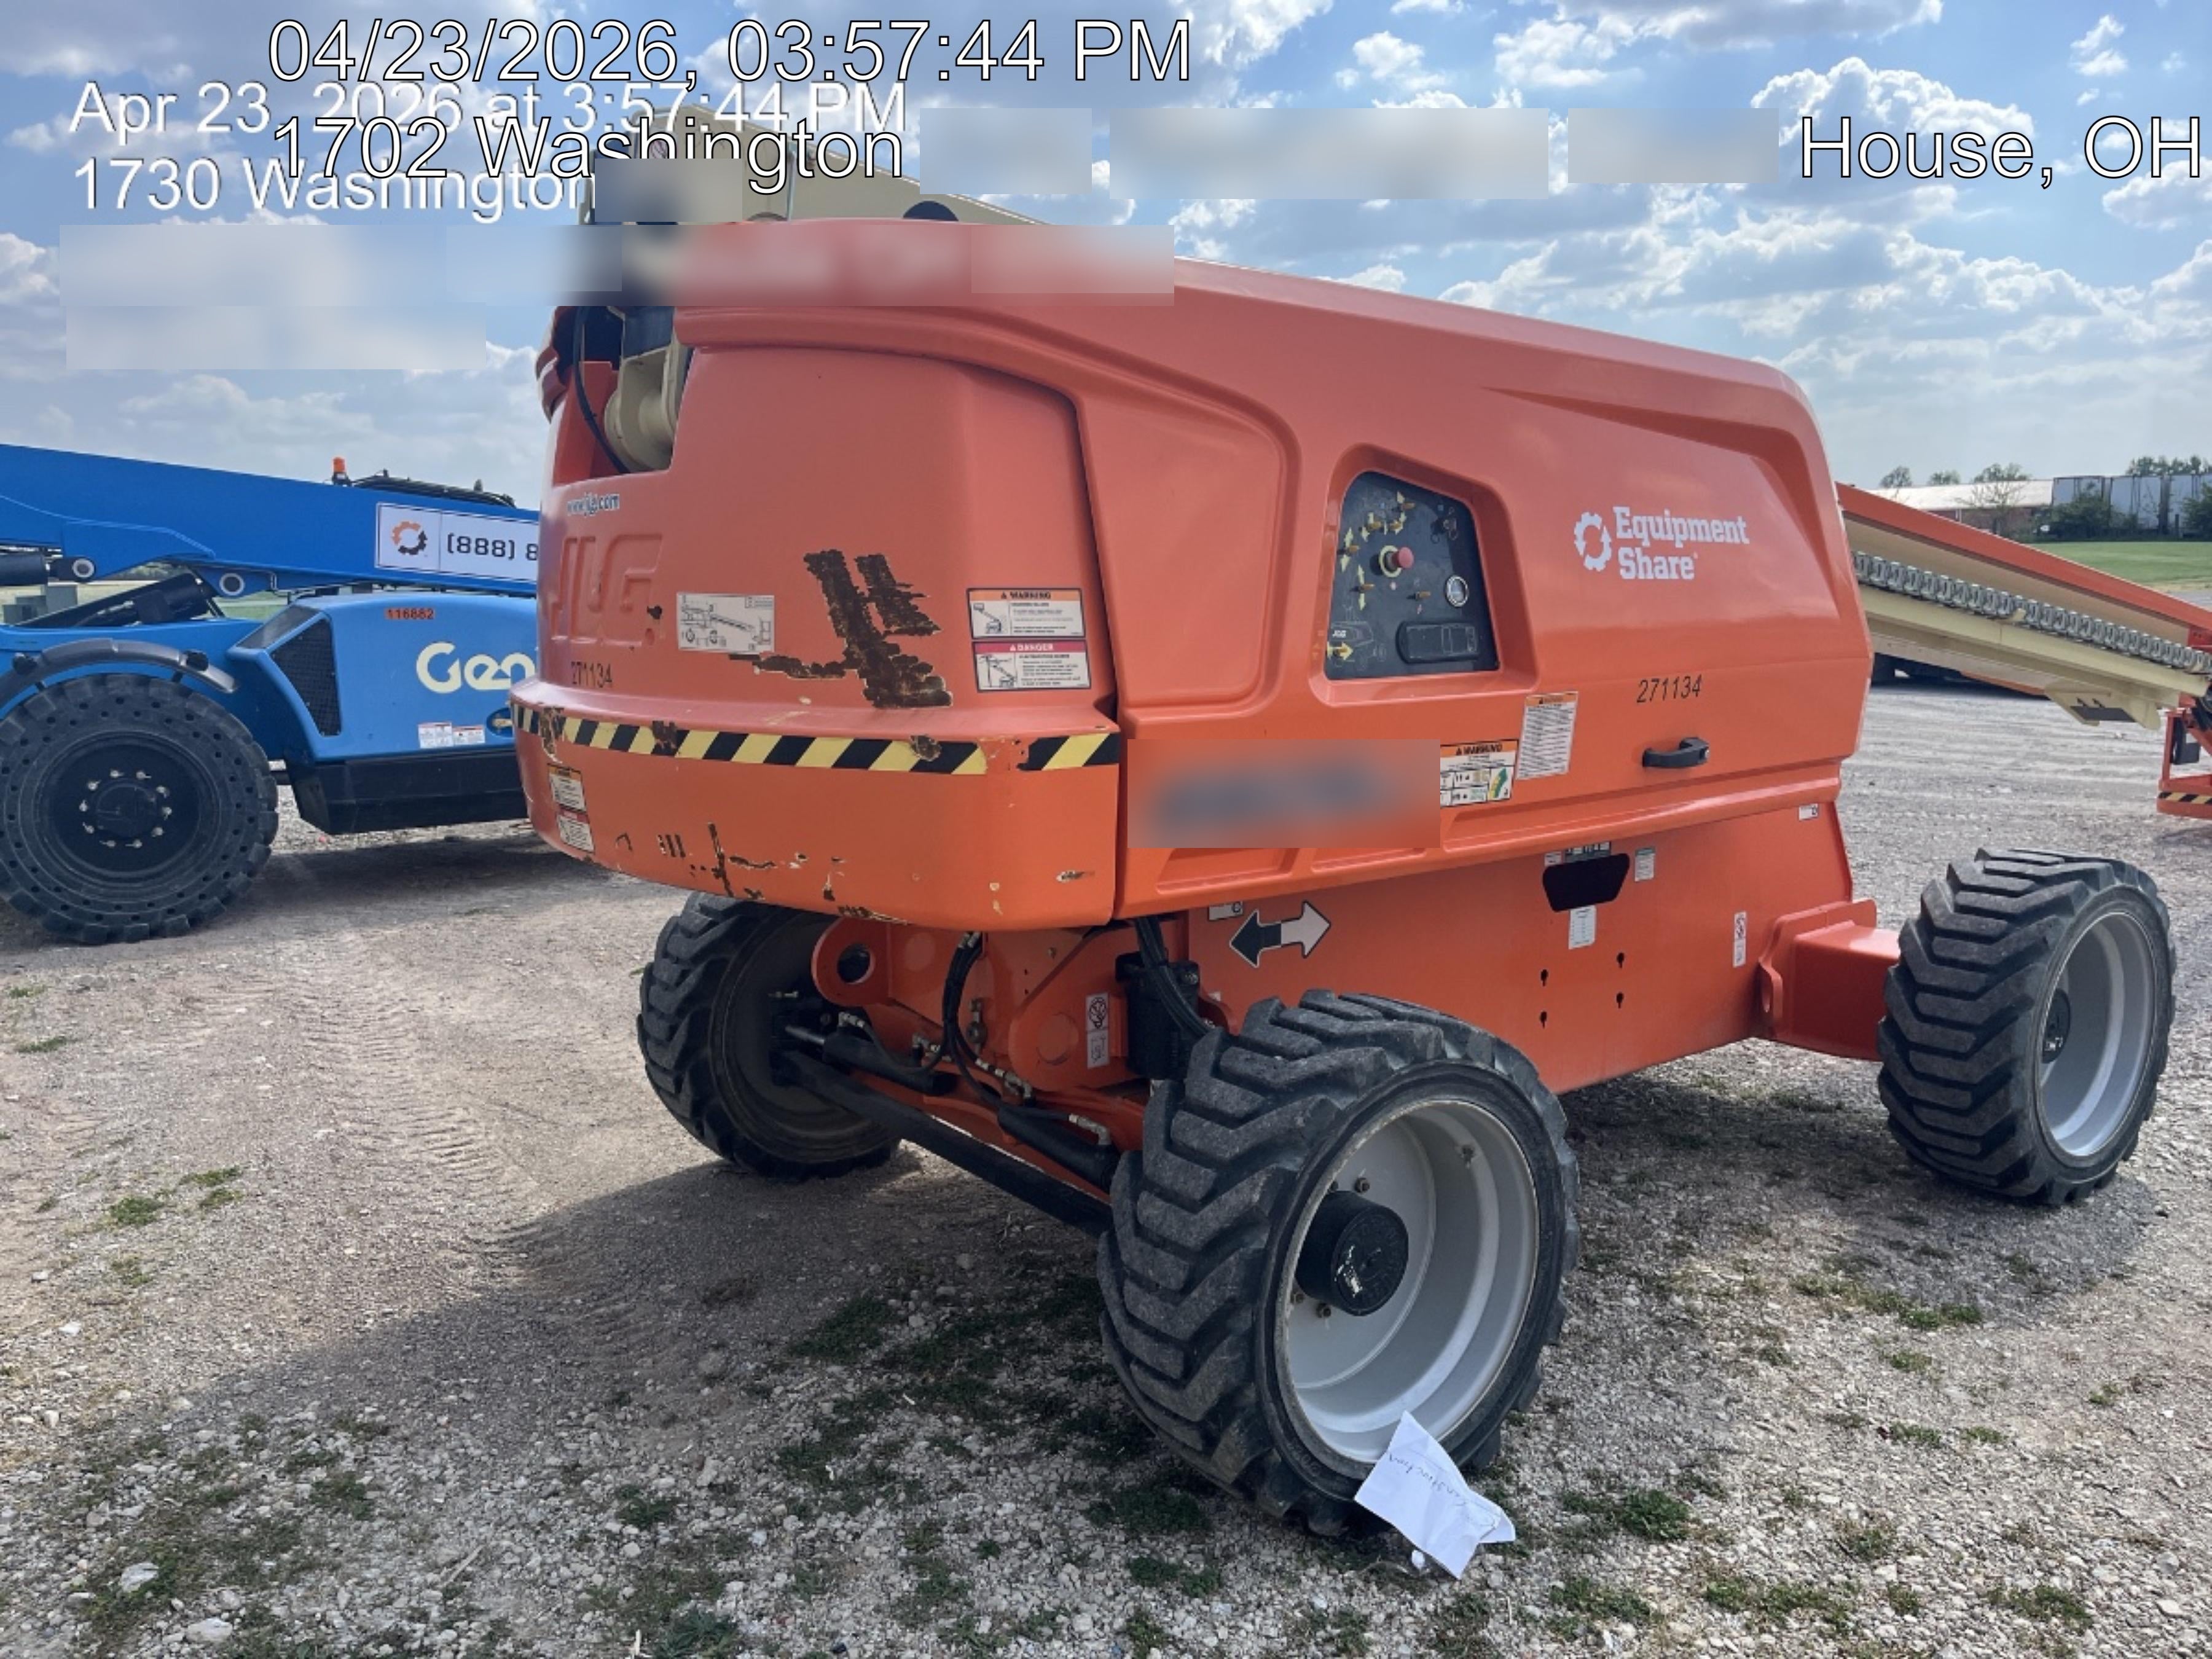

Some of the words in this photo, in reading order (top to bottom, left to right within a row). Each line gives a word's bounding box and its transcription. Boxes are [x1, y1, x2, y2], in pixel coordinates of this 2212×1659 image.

[1613, 506, 1750, 548] Equipment
[447, 532, 515, 560] (888)
[1618, 546, 1695, 579] Share
[1636, 673, 1702, 704] 271134
